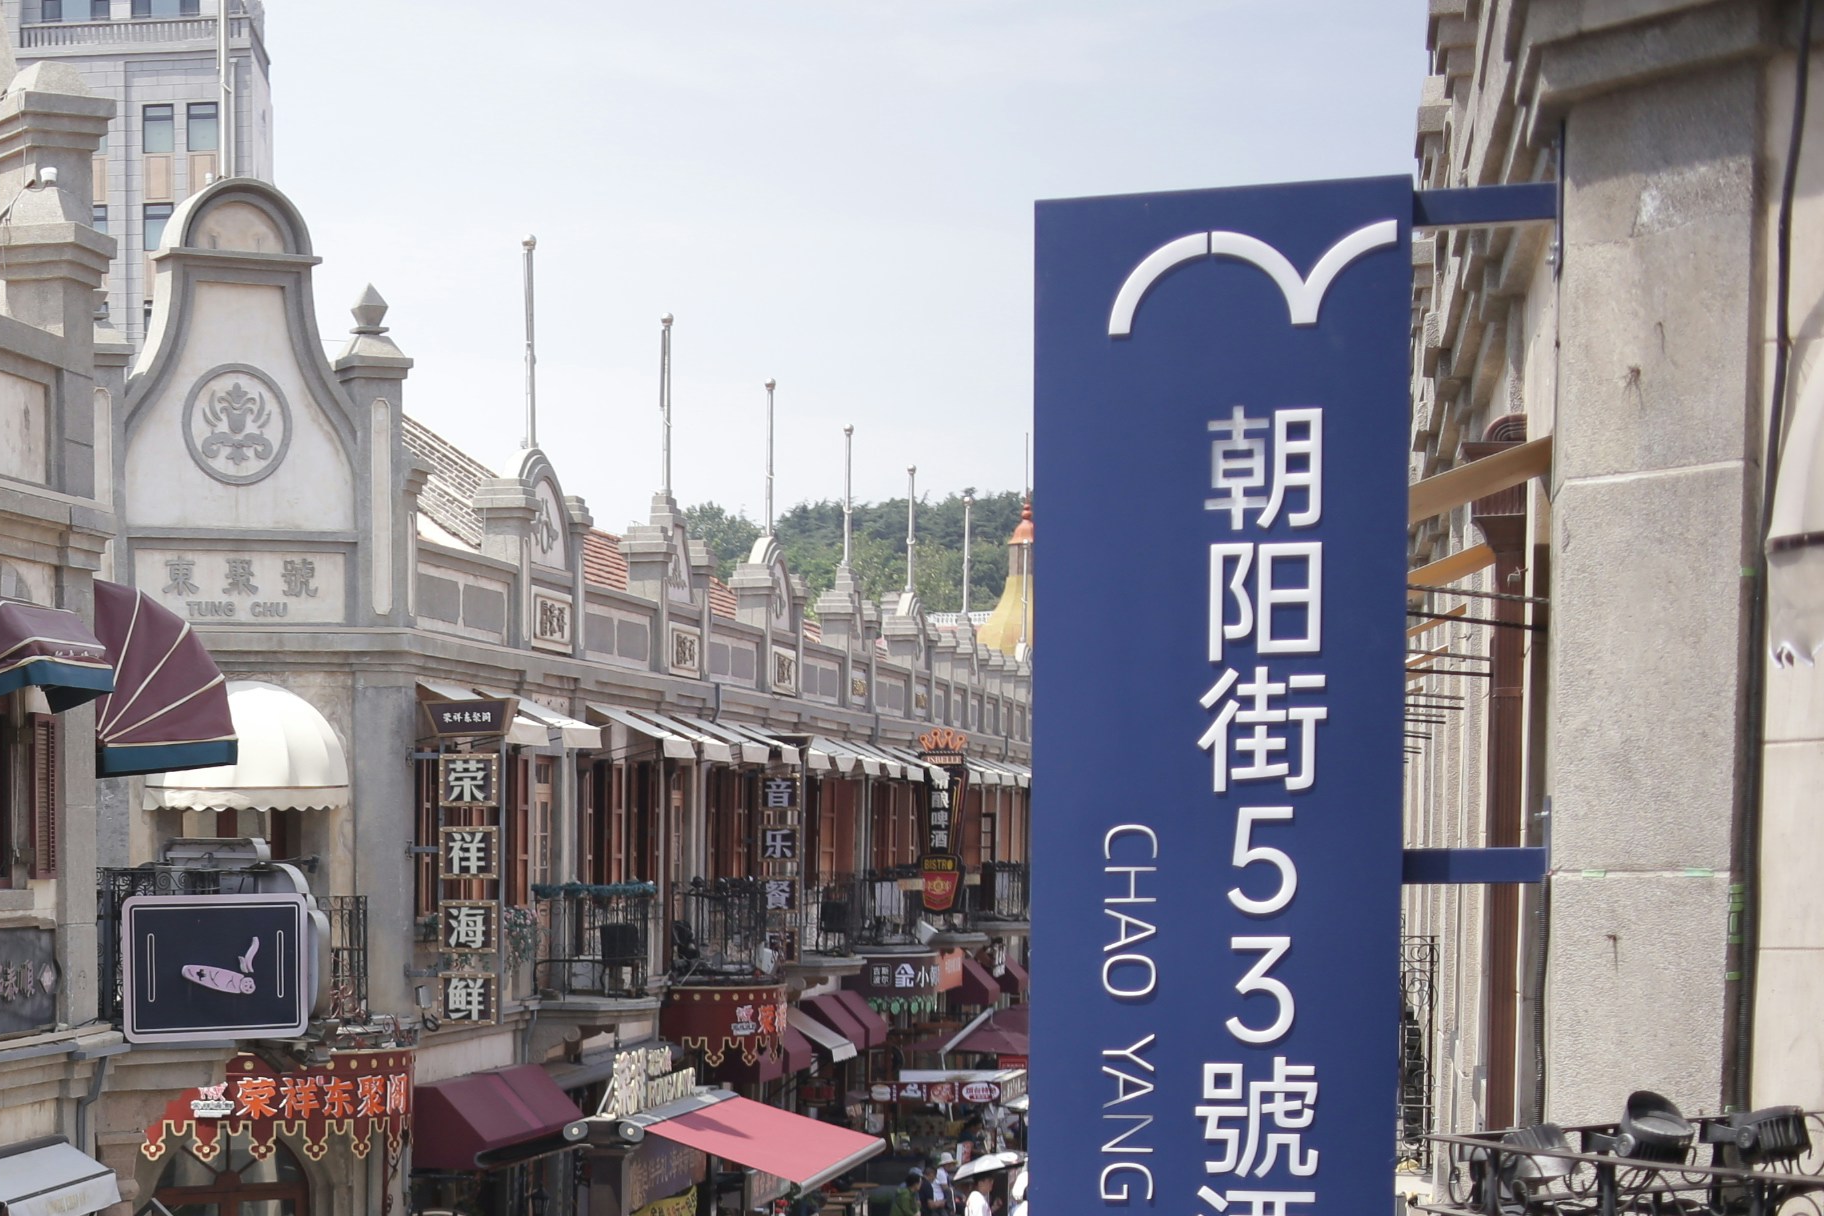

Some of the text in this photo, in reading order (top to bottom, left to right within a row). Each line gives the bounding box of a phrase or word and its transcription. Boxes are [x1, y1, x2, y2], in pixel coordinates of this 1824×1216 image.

[186, 600, 288, 617] TUNG CHU
[447, 760, 487, 1022] 荣祥海鲜
[924, 859, 955, 870] BISTRO
[1103, 825, 1158, 998] CHAO
[1100, 1034, 1155, 1203] YANG
